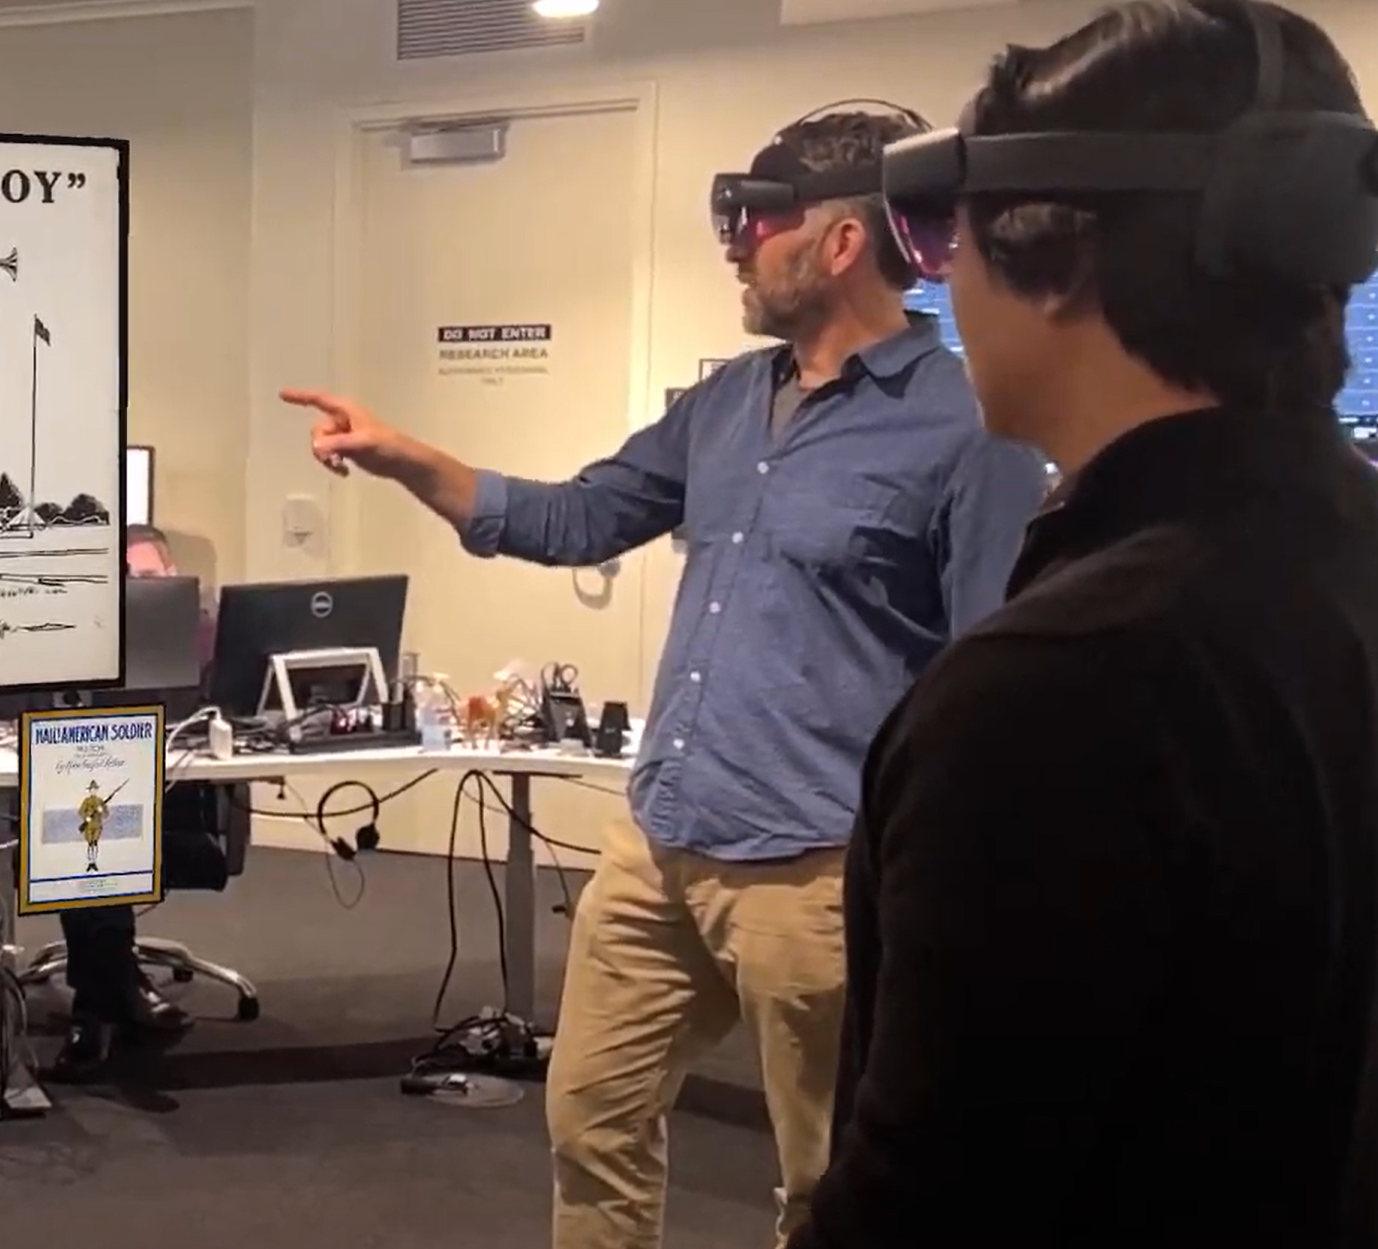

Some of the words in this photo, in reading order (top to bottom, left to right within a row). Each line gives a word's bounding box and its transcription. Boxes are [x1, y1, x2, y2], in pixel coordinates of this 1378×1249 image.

[444, 329, 463, 340] DO
[468, 328, 496, 340] NOT
[501, 326, 547, 339] ENTER
[439, 348, 509, 360] RESEARCH
[512, 347, 549, 359] AREA
[62, 725, 109, 744] AMERICAN
[110, 721, 153, 741] SOLDIER
